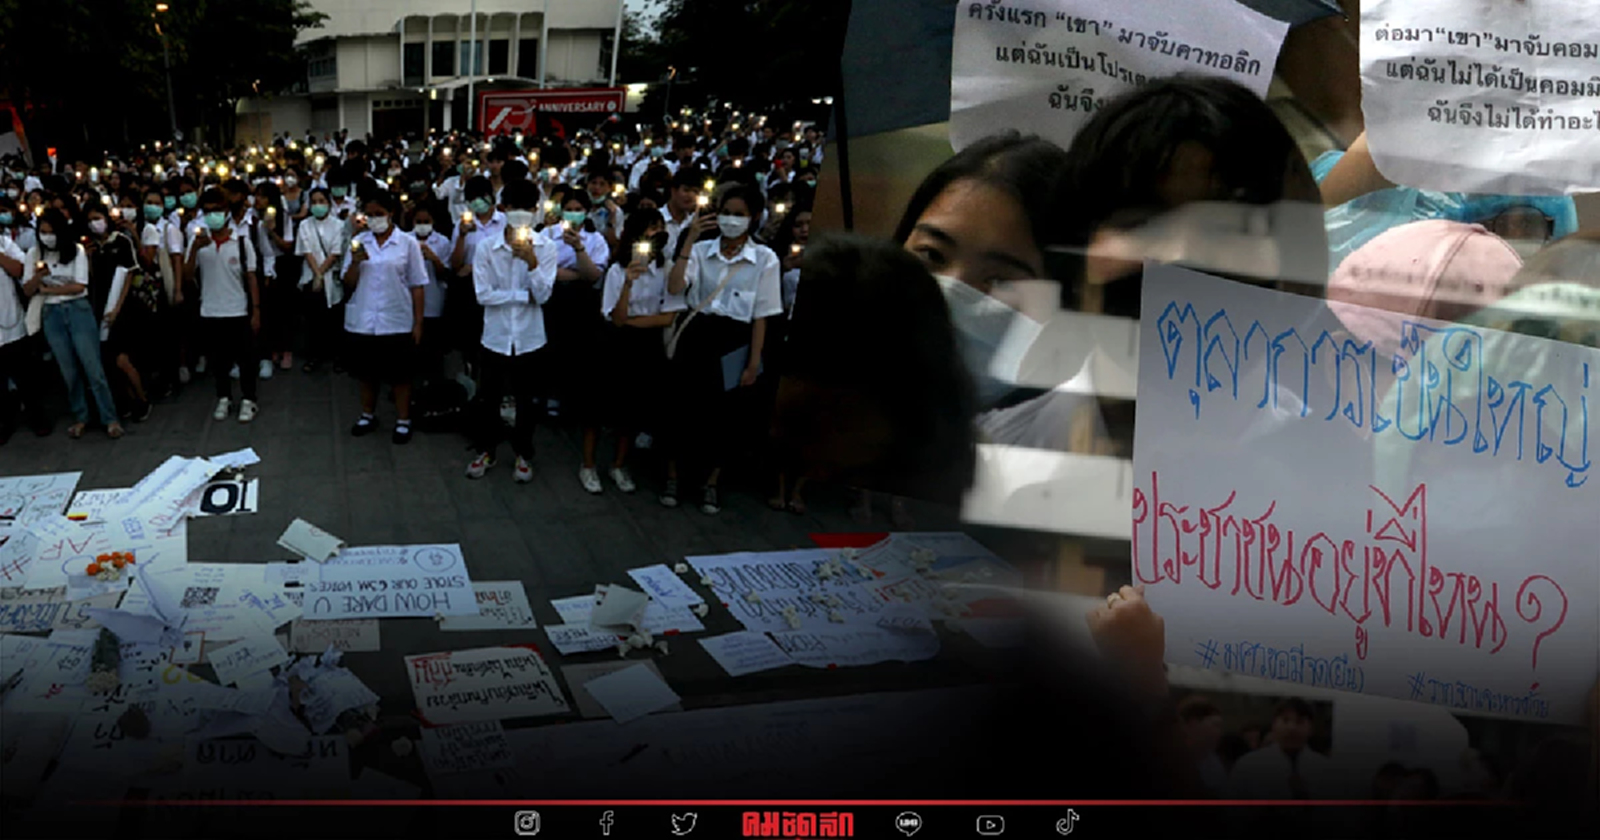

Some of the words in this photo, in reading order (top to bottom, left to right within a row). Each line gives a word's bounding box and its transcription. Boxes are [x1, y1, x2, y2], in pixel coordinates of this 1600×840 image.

[1056, 12, 1112, 37] “เขา”
[1118, 27, 1261, 77] มาจับคาทอลิก
[538, 101, 605, 113] ANNIVERSARY
[1157, 301, 1591, 488] ตุลาการเป็นใหญ่
[391, 578, 418, 590] OUR
[423, 575, 465, 590] STOLE
[313, 596, 331, 613] U
[342, 595, 387, 613] DARE
[394, 592, 450, 614] HOW
